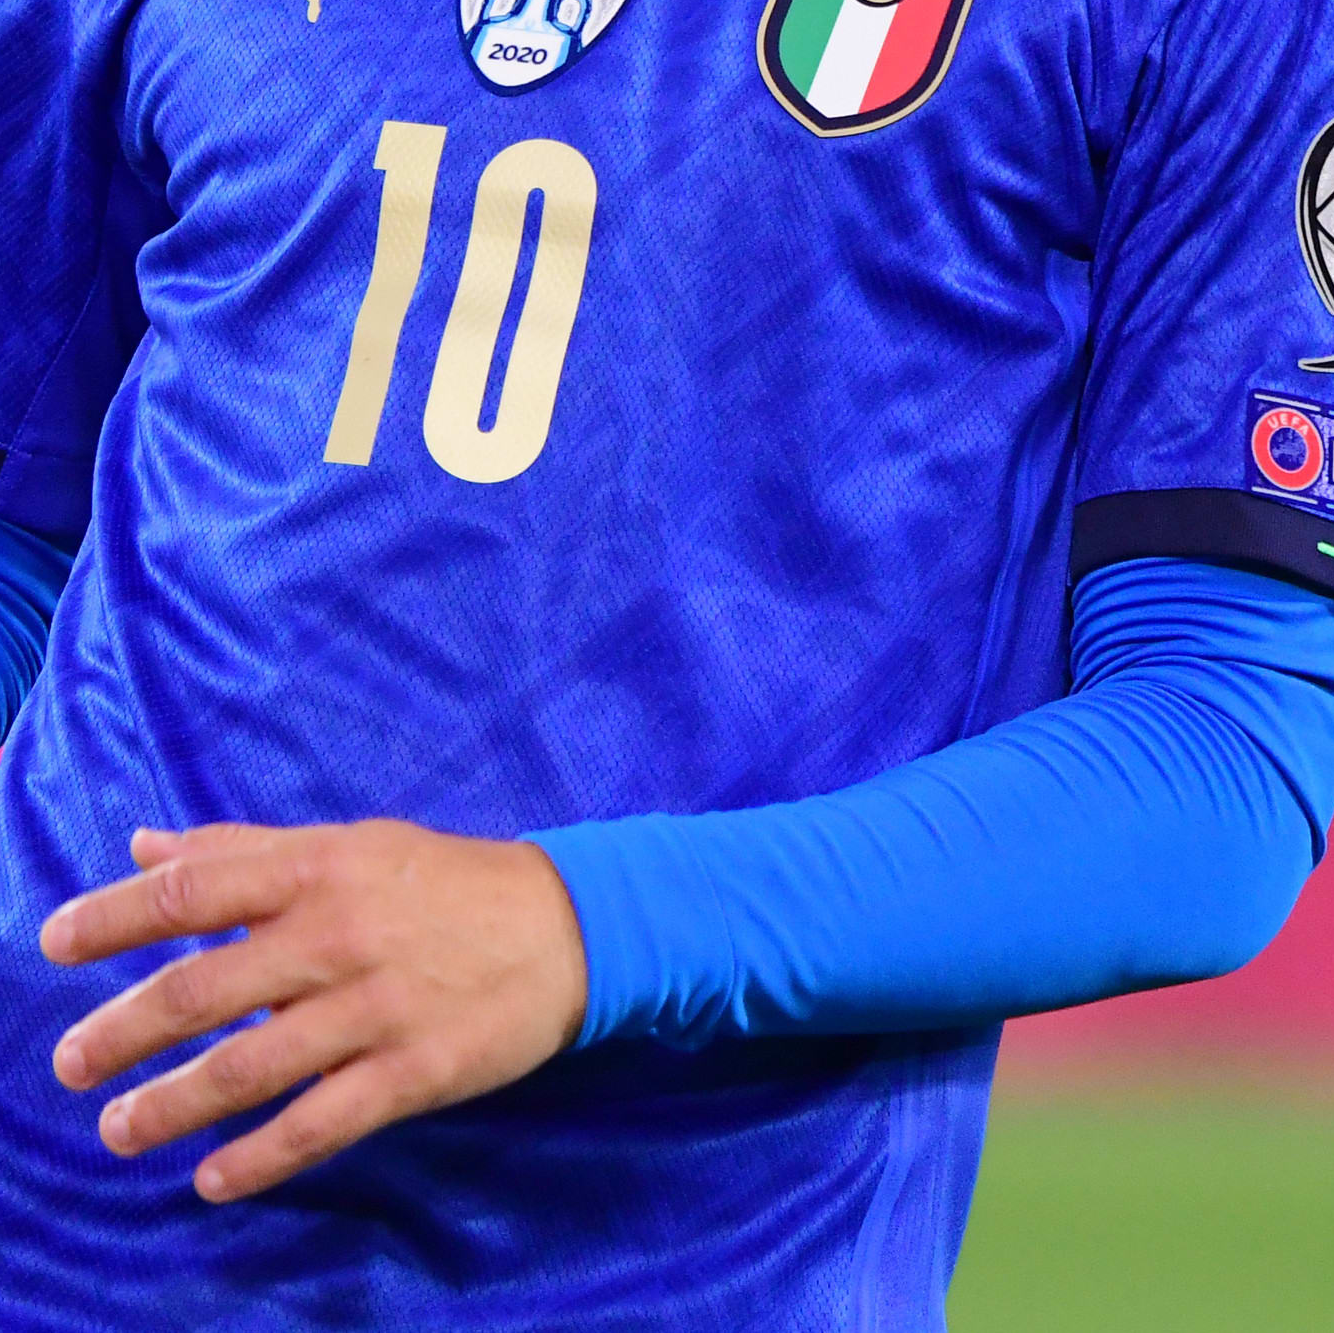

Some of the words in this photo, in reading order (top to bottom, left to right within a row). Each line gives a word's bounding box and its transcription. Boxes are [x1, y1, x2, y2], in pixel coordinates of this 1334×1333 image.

[488, 43, 548, 65] 2020
[323, 120, 598, 484] 10
[1267, 413, 1309, 435] UEFA
